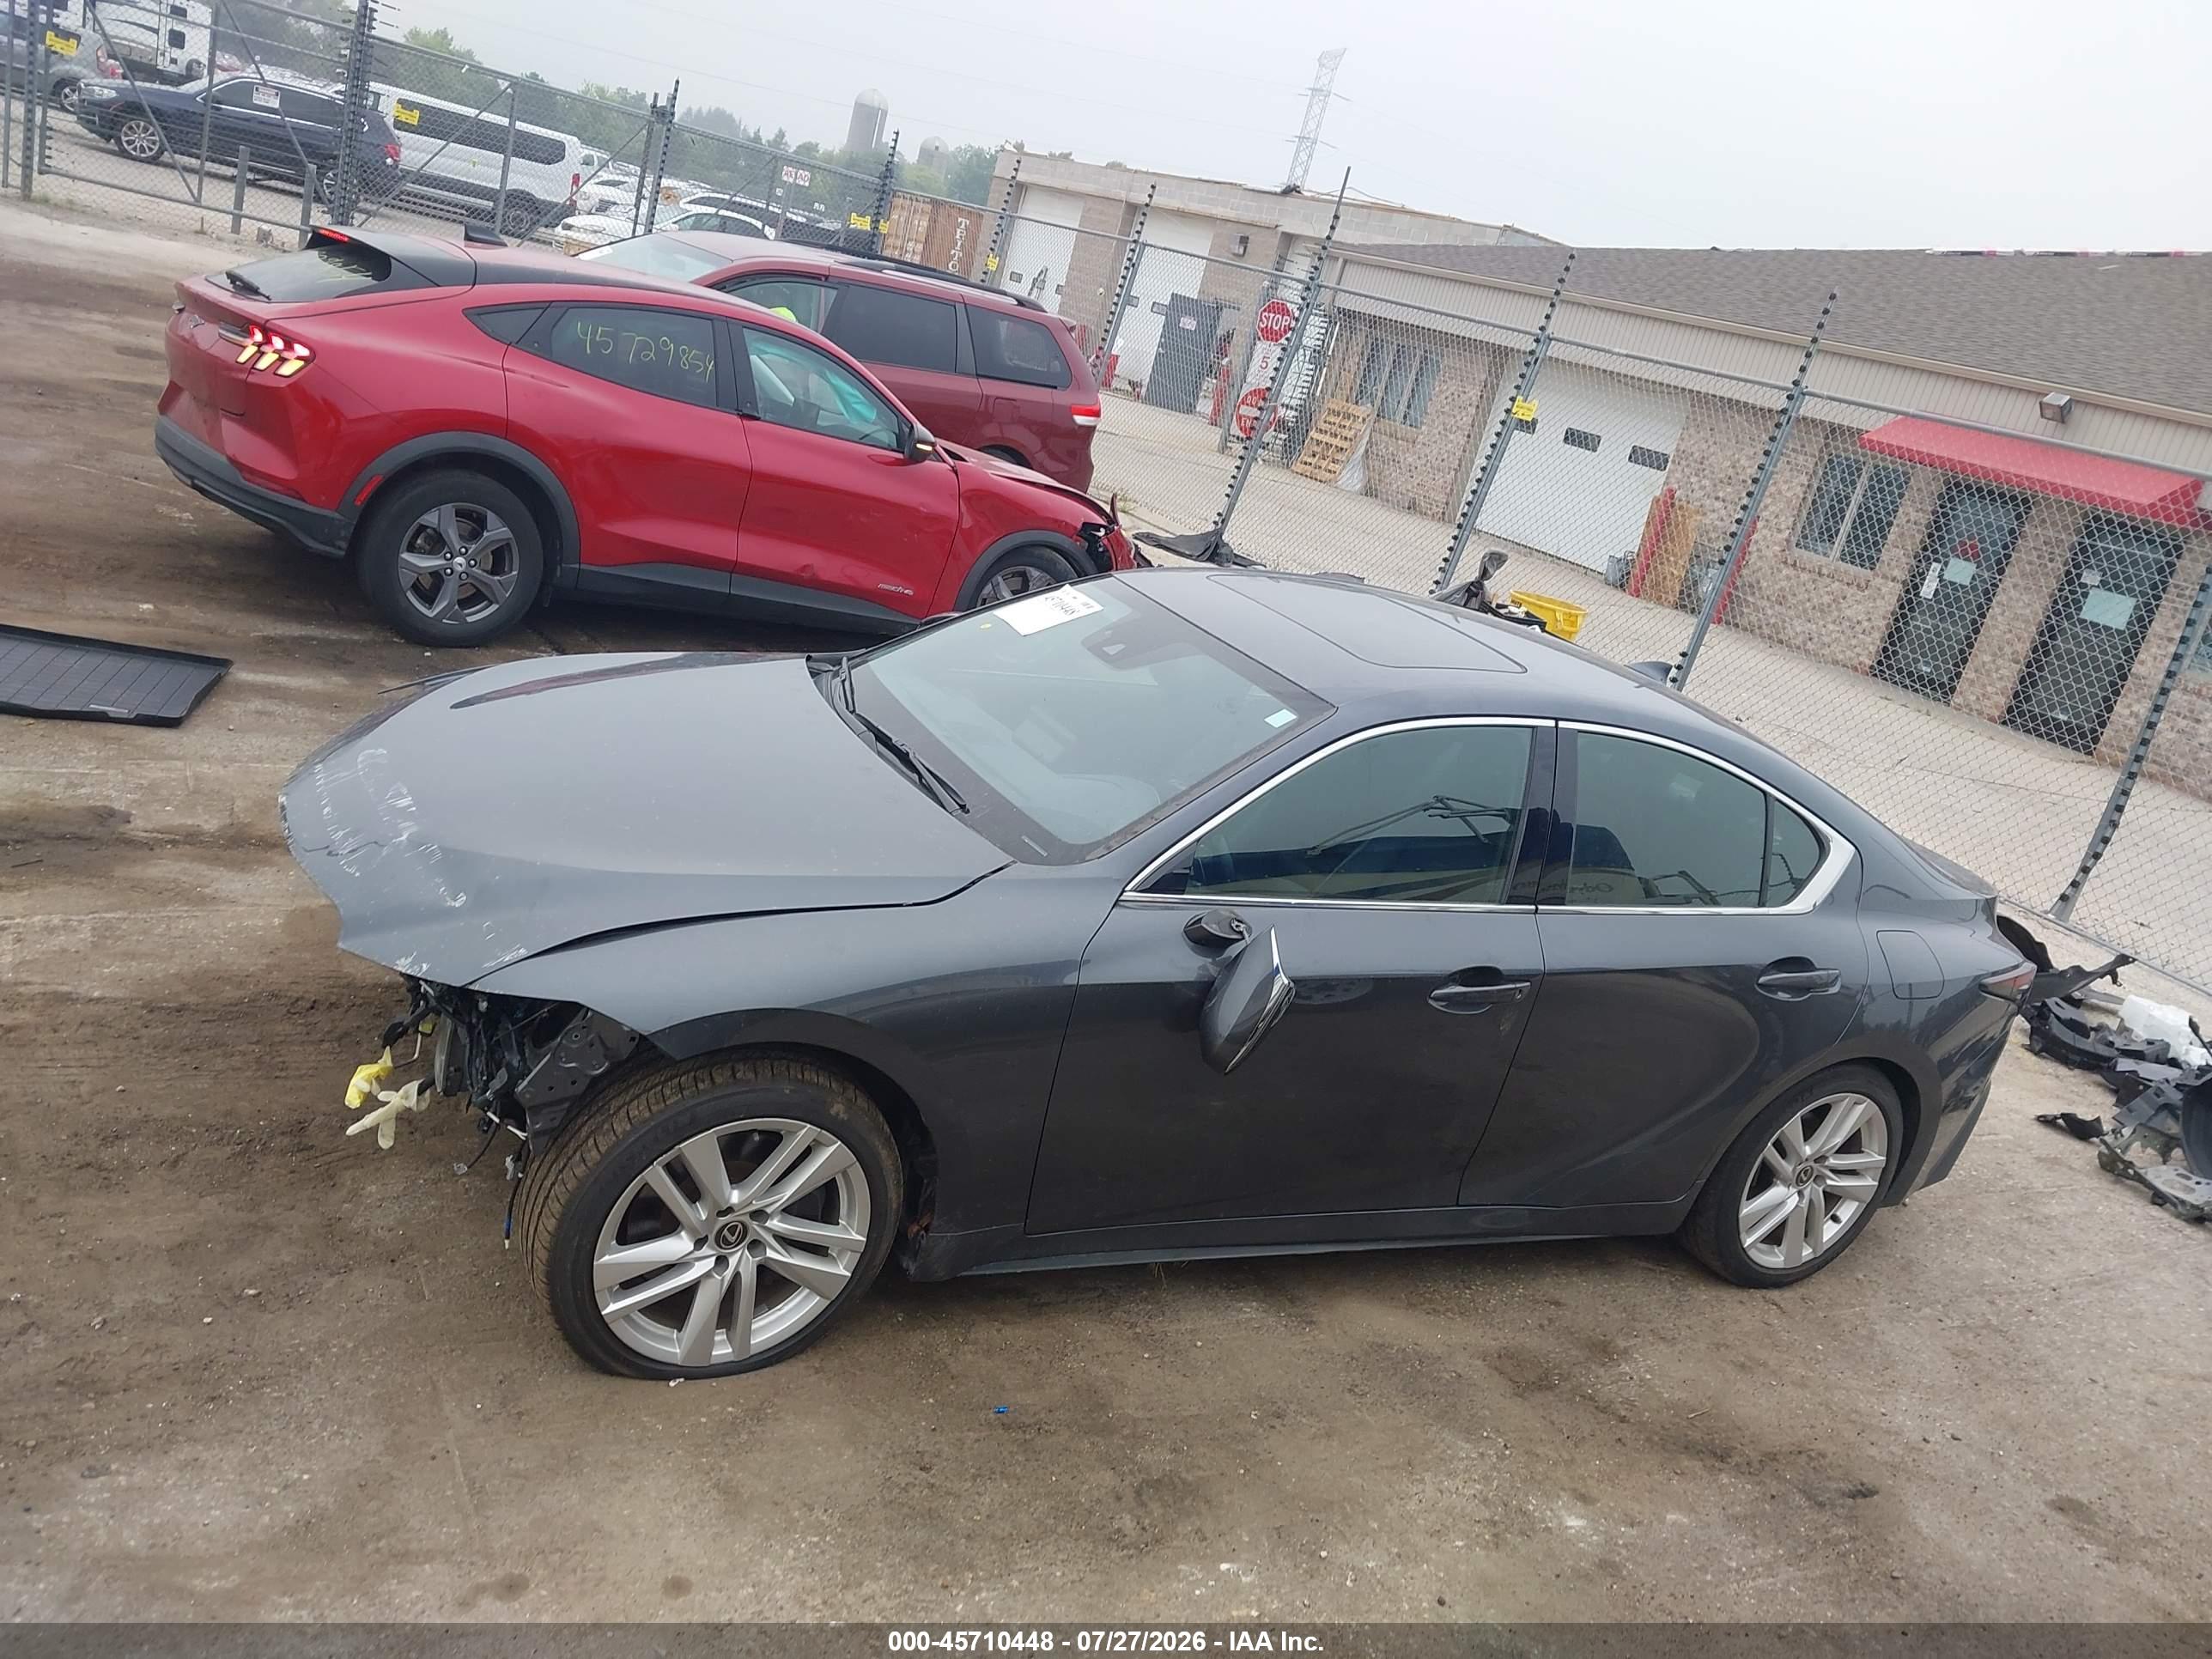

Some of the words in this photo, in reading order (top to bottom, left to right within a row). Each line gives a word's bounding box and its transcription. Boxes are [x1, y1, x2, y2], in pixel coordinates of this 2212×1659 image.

[947, 217, 969, 275] TRITO
[1260, 312, 1291, 331] STOP
[577, 321, 714, 383] 45729854
[1260, 356, 1270, 369] 5
